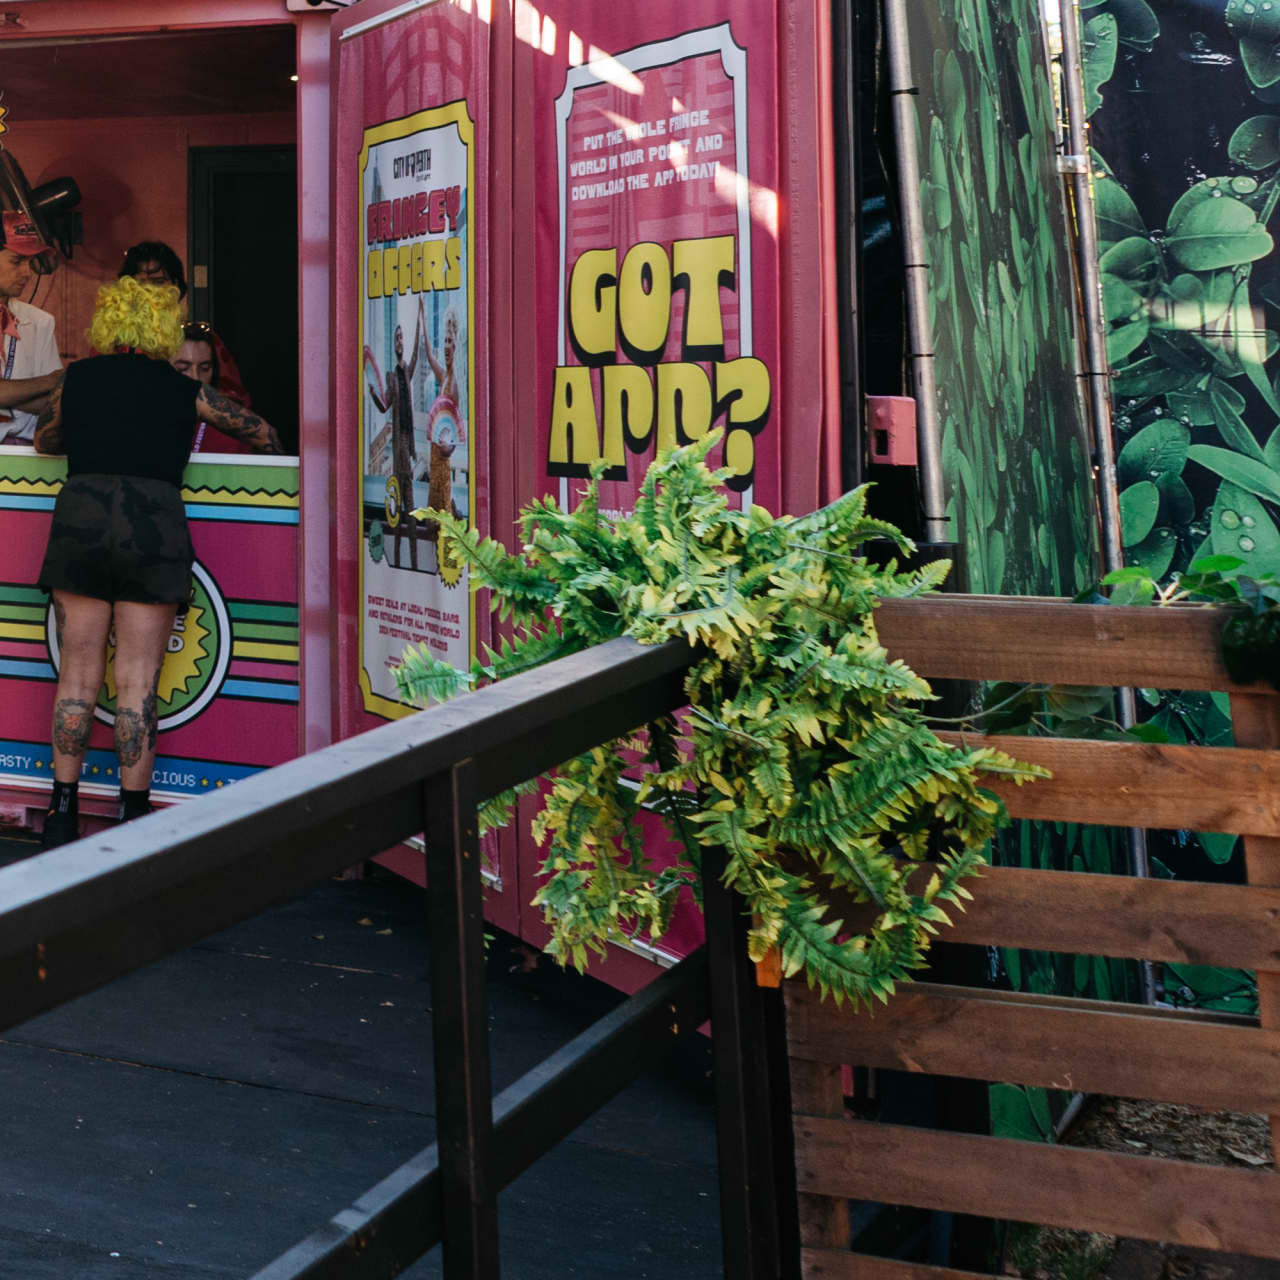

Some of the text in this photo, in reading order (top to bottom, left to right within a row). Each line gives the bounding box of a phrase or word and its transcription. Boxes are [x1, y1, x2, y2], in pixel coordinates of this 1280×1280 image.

[570, 157, 607, 177] WORLD
[620, 149, 645, 168] YOUR
[695, 134, 723, 153] AND
[583, 134, 604, 151] PUT
[606, 128, 624, 146] THE
[669, 109, 710, 133] FRINGE
[367, 185, 461, 245] FRINGEY
[571, 179, 625, 201] DOWNLOAD
[627, 173, 650, 191] THE
[653, 169, 675, 188] APP
[368, 236, 461, 299] OFFERS
[568, 234, 737, 365] GOT
[548, 356, 771, 492] APP?
